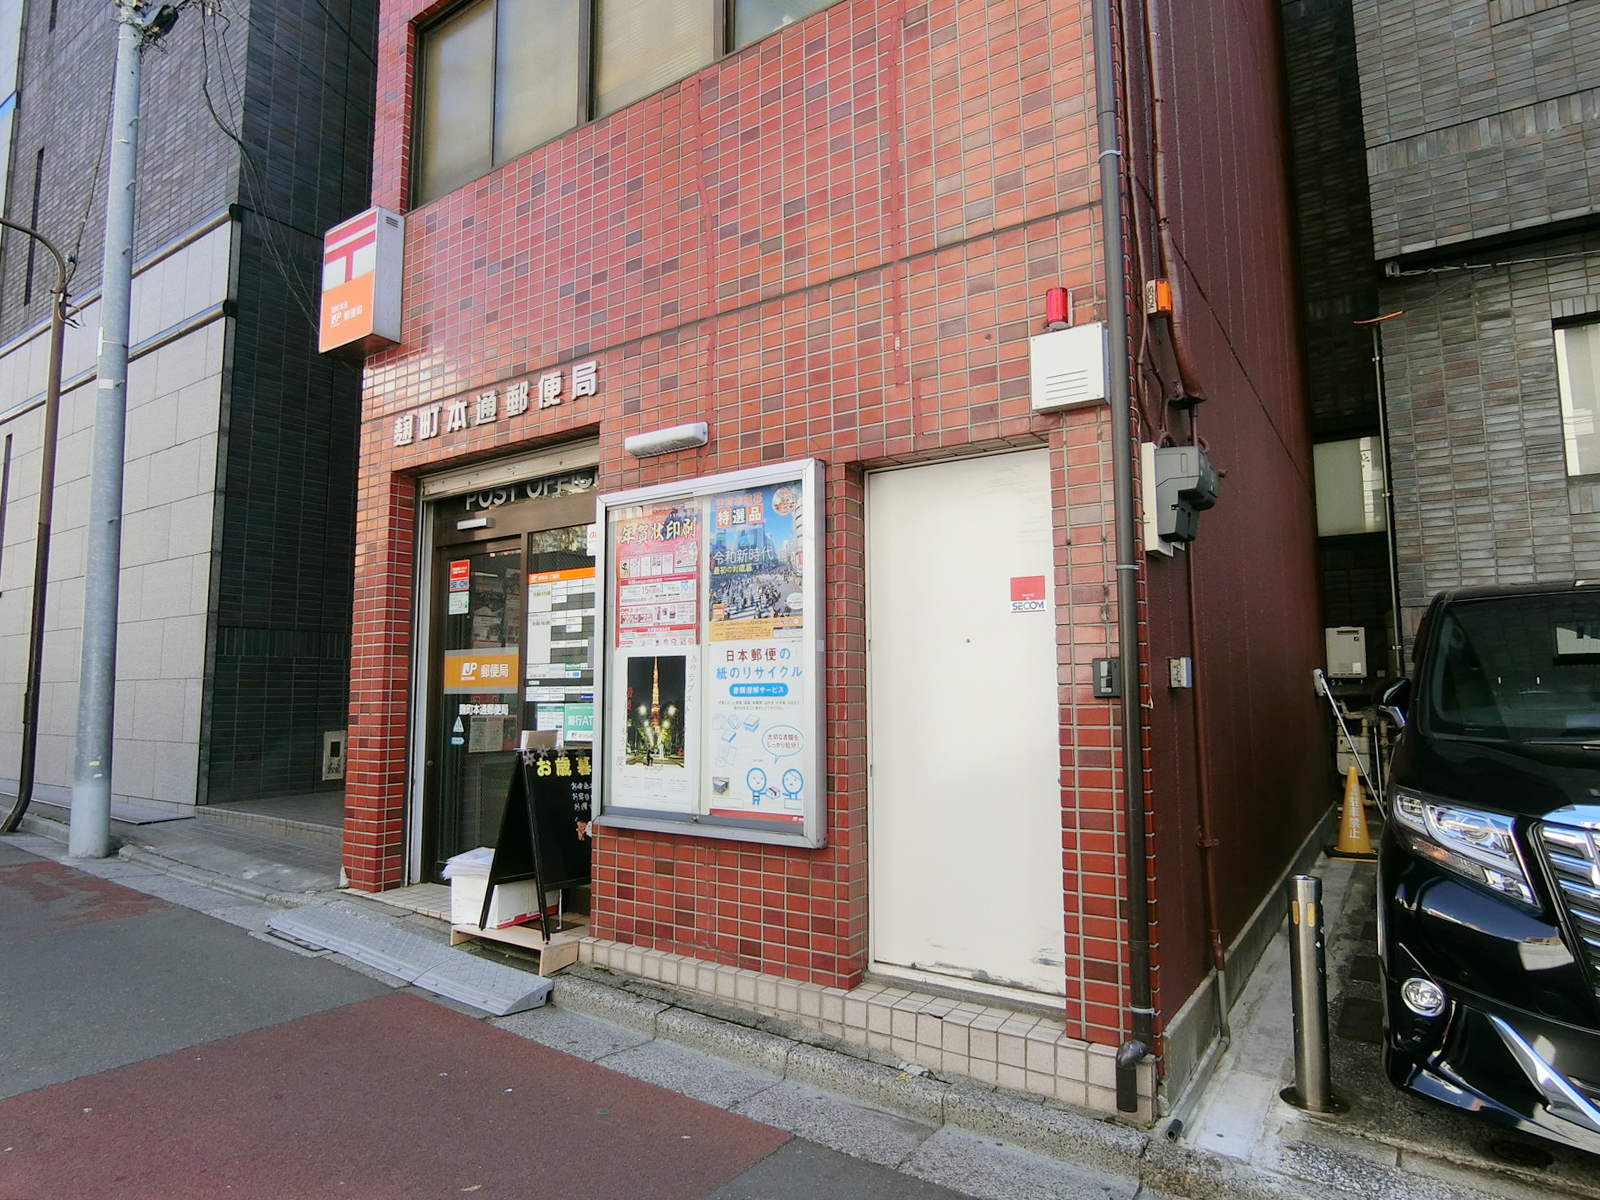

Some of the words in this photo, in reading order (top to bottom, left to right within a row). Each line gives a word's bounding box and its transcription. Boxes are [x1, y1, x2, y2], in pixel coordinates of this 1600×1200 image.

[393, 360, 599, 447] 麹町本通郵便局
[716, 505, 763, 527] 特選品
[620, 517, 698, 545] 年賀状印刷
[713, 545, 774, 566] 令和新時代
[1012, 601, 1045, 610] SECOM
[726, 648, 791, 662] 日本郵便の
[480, 663, 509, 678] 郵便局
[716, 666, 803, 680] 紙のリサイクル
[767, 733, 799, 741] 大切な書類を
